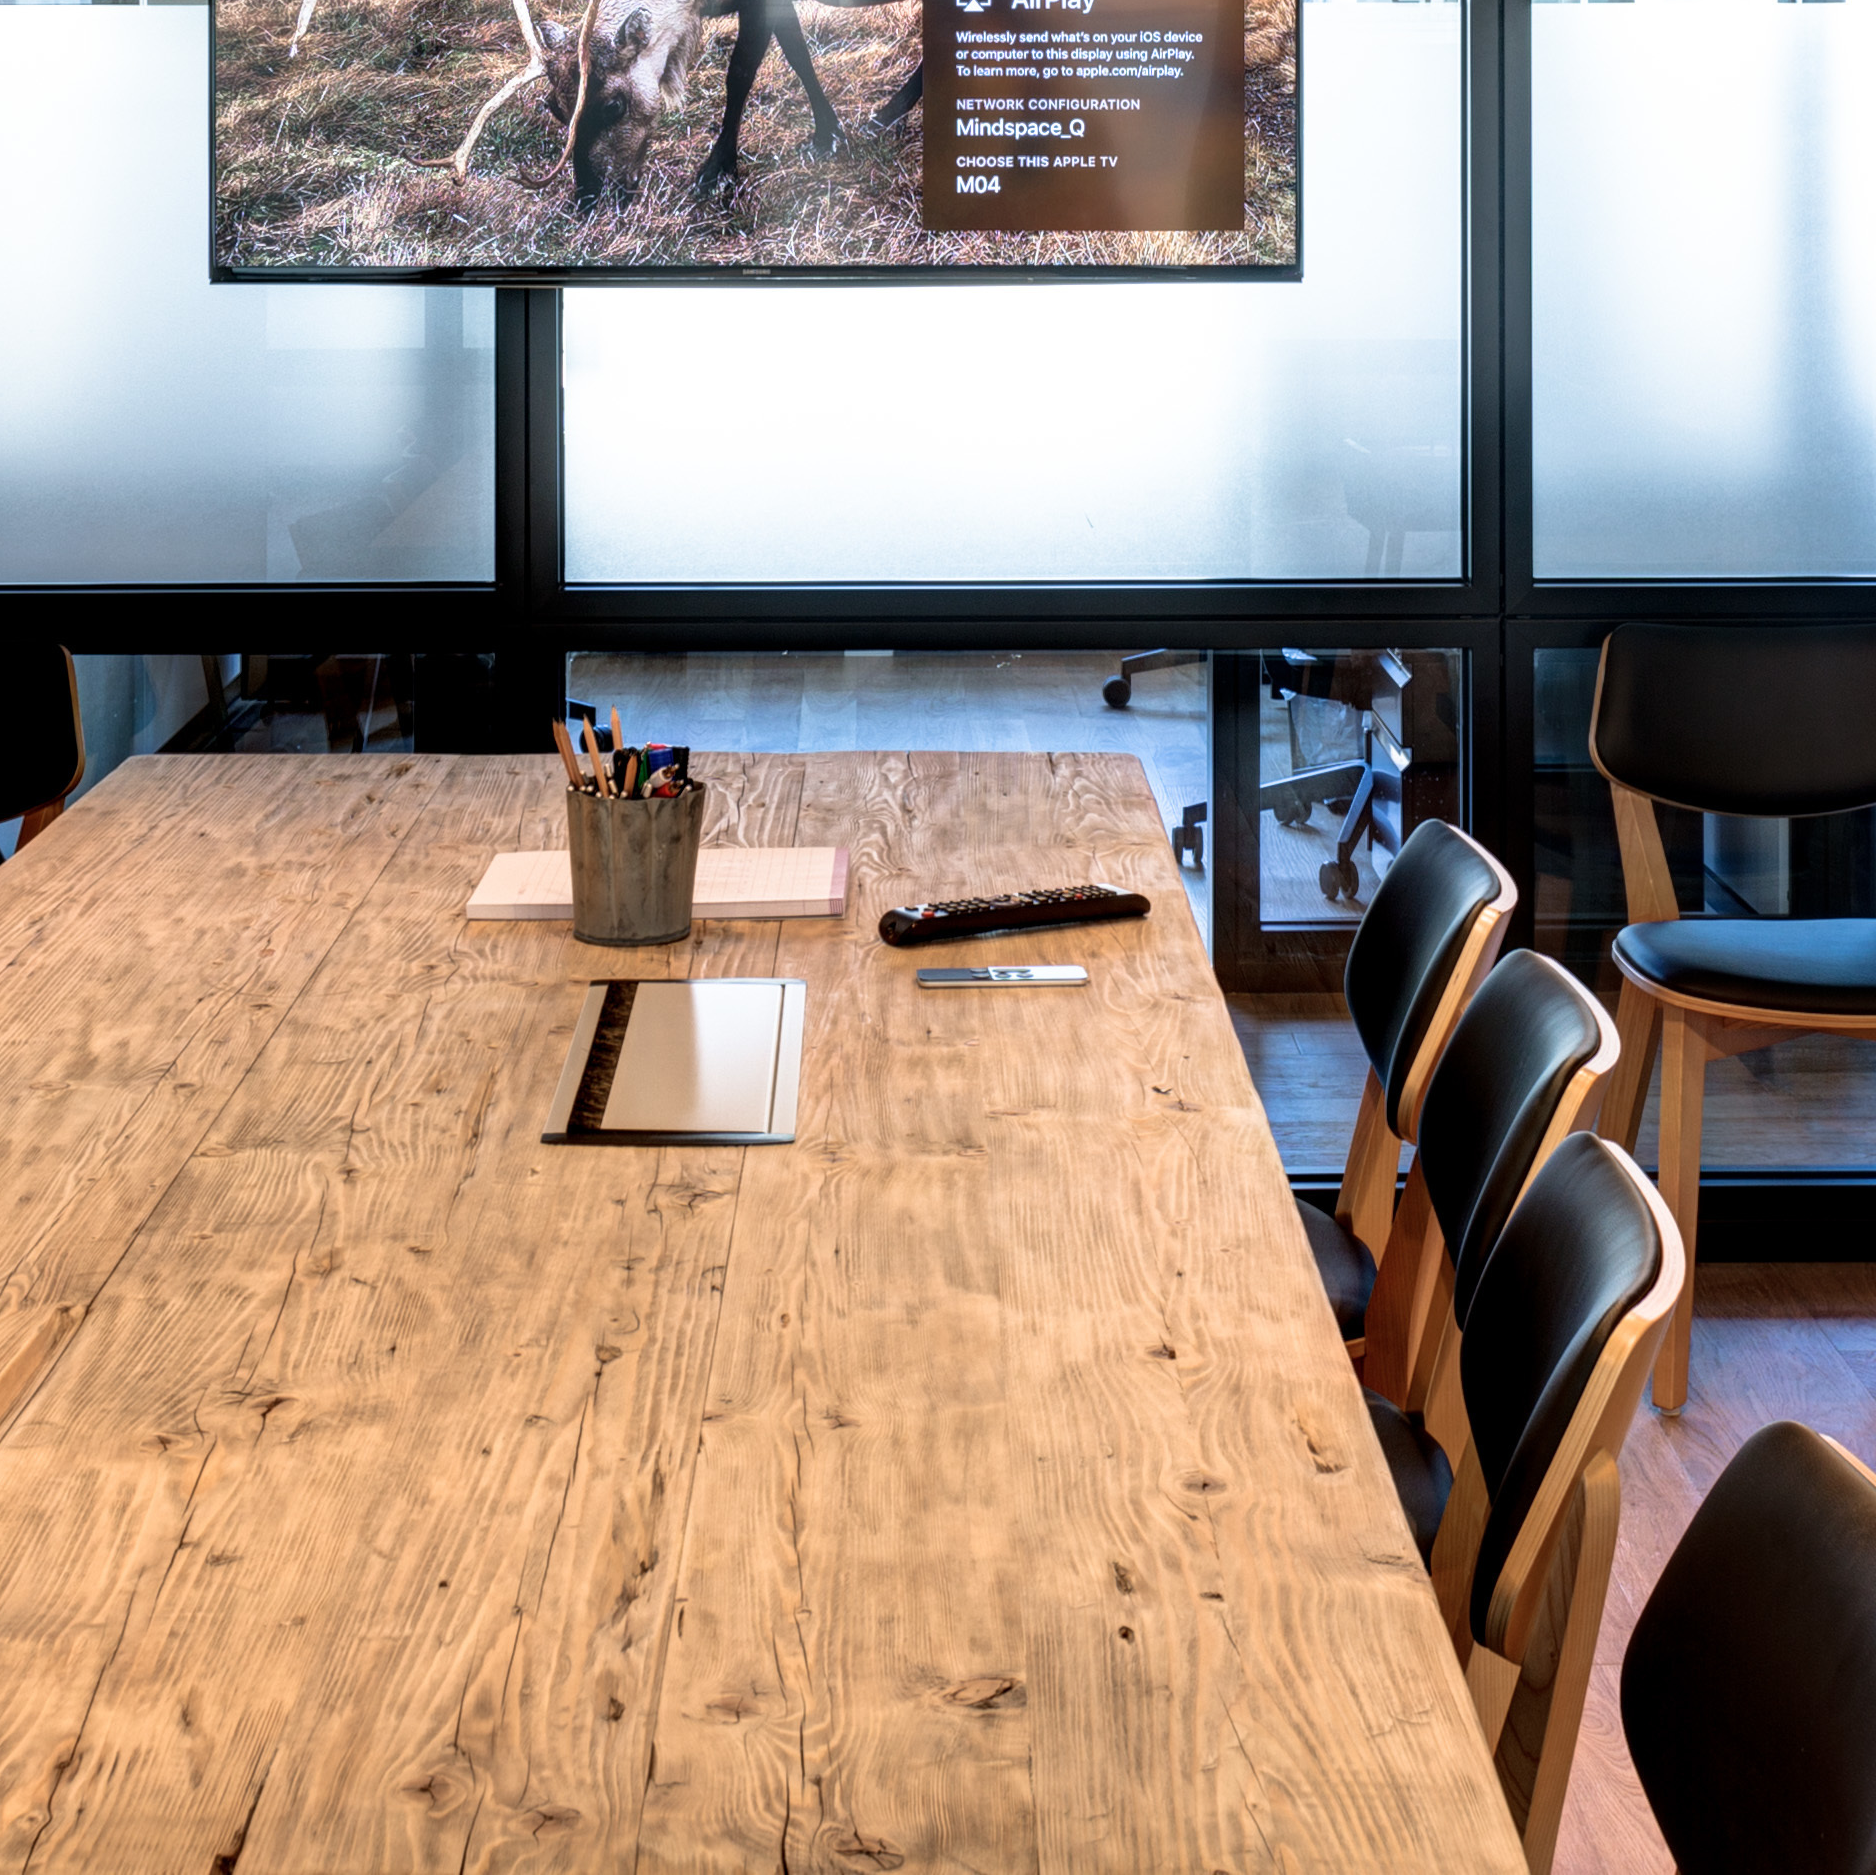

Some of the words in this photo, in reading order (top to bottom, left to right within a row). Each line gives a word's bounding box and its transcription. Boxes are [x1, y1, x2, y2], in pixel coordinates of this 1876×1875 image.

[956, 31, 1016, 45] Wirelessly
[1019, 31, 1048, 43] send
[1051, 31, 1090, 43] what's
[1092, 33, 1108, 43] on
[1110, 33, 1138, 45] your
[1139, 31, 1162, 43] iOS
[1163, 31, 1203, 43] device
[955, 50, 969, 60] or
[971, 49, 1029, 62] computer
[1031, 49, 1044, 60] to
[1046, 47, 1068, 60] this
[1070, 47, 1113, 62] display
[1115, 47, 1148, 62] using
[1151, 47, 1195, 62] AirPlay.
[956, 65, 971, 76] To
[973, 65, 1004, 76] learn
[1005, 66, 1040, 79] more,
[1042, 66, 1058, 79] go
[1060, 65, 1074, 76] to
[1076, 65, 1184, 79] apple.com/airplay.
[956, 99, 1024, 110] NETWORK
[1028, 99, 1141, 110] CONFIGURATION
[956, 118, 1085, 140] Mindspace_Q
[956, 156, 1014, 167] CHOOSE
[1018, 156, 1049, 167] THIS
[1053, 156, 1096, 167] APPLE
[1100, 156, 1118, 167] TV
[956, 175, 1001, 194] M04
